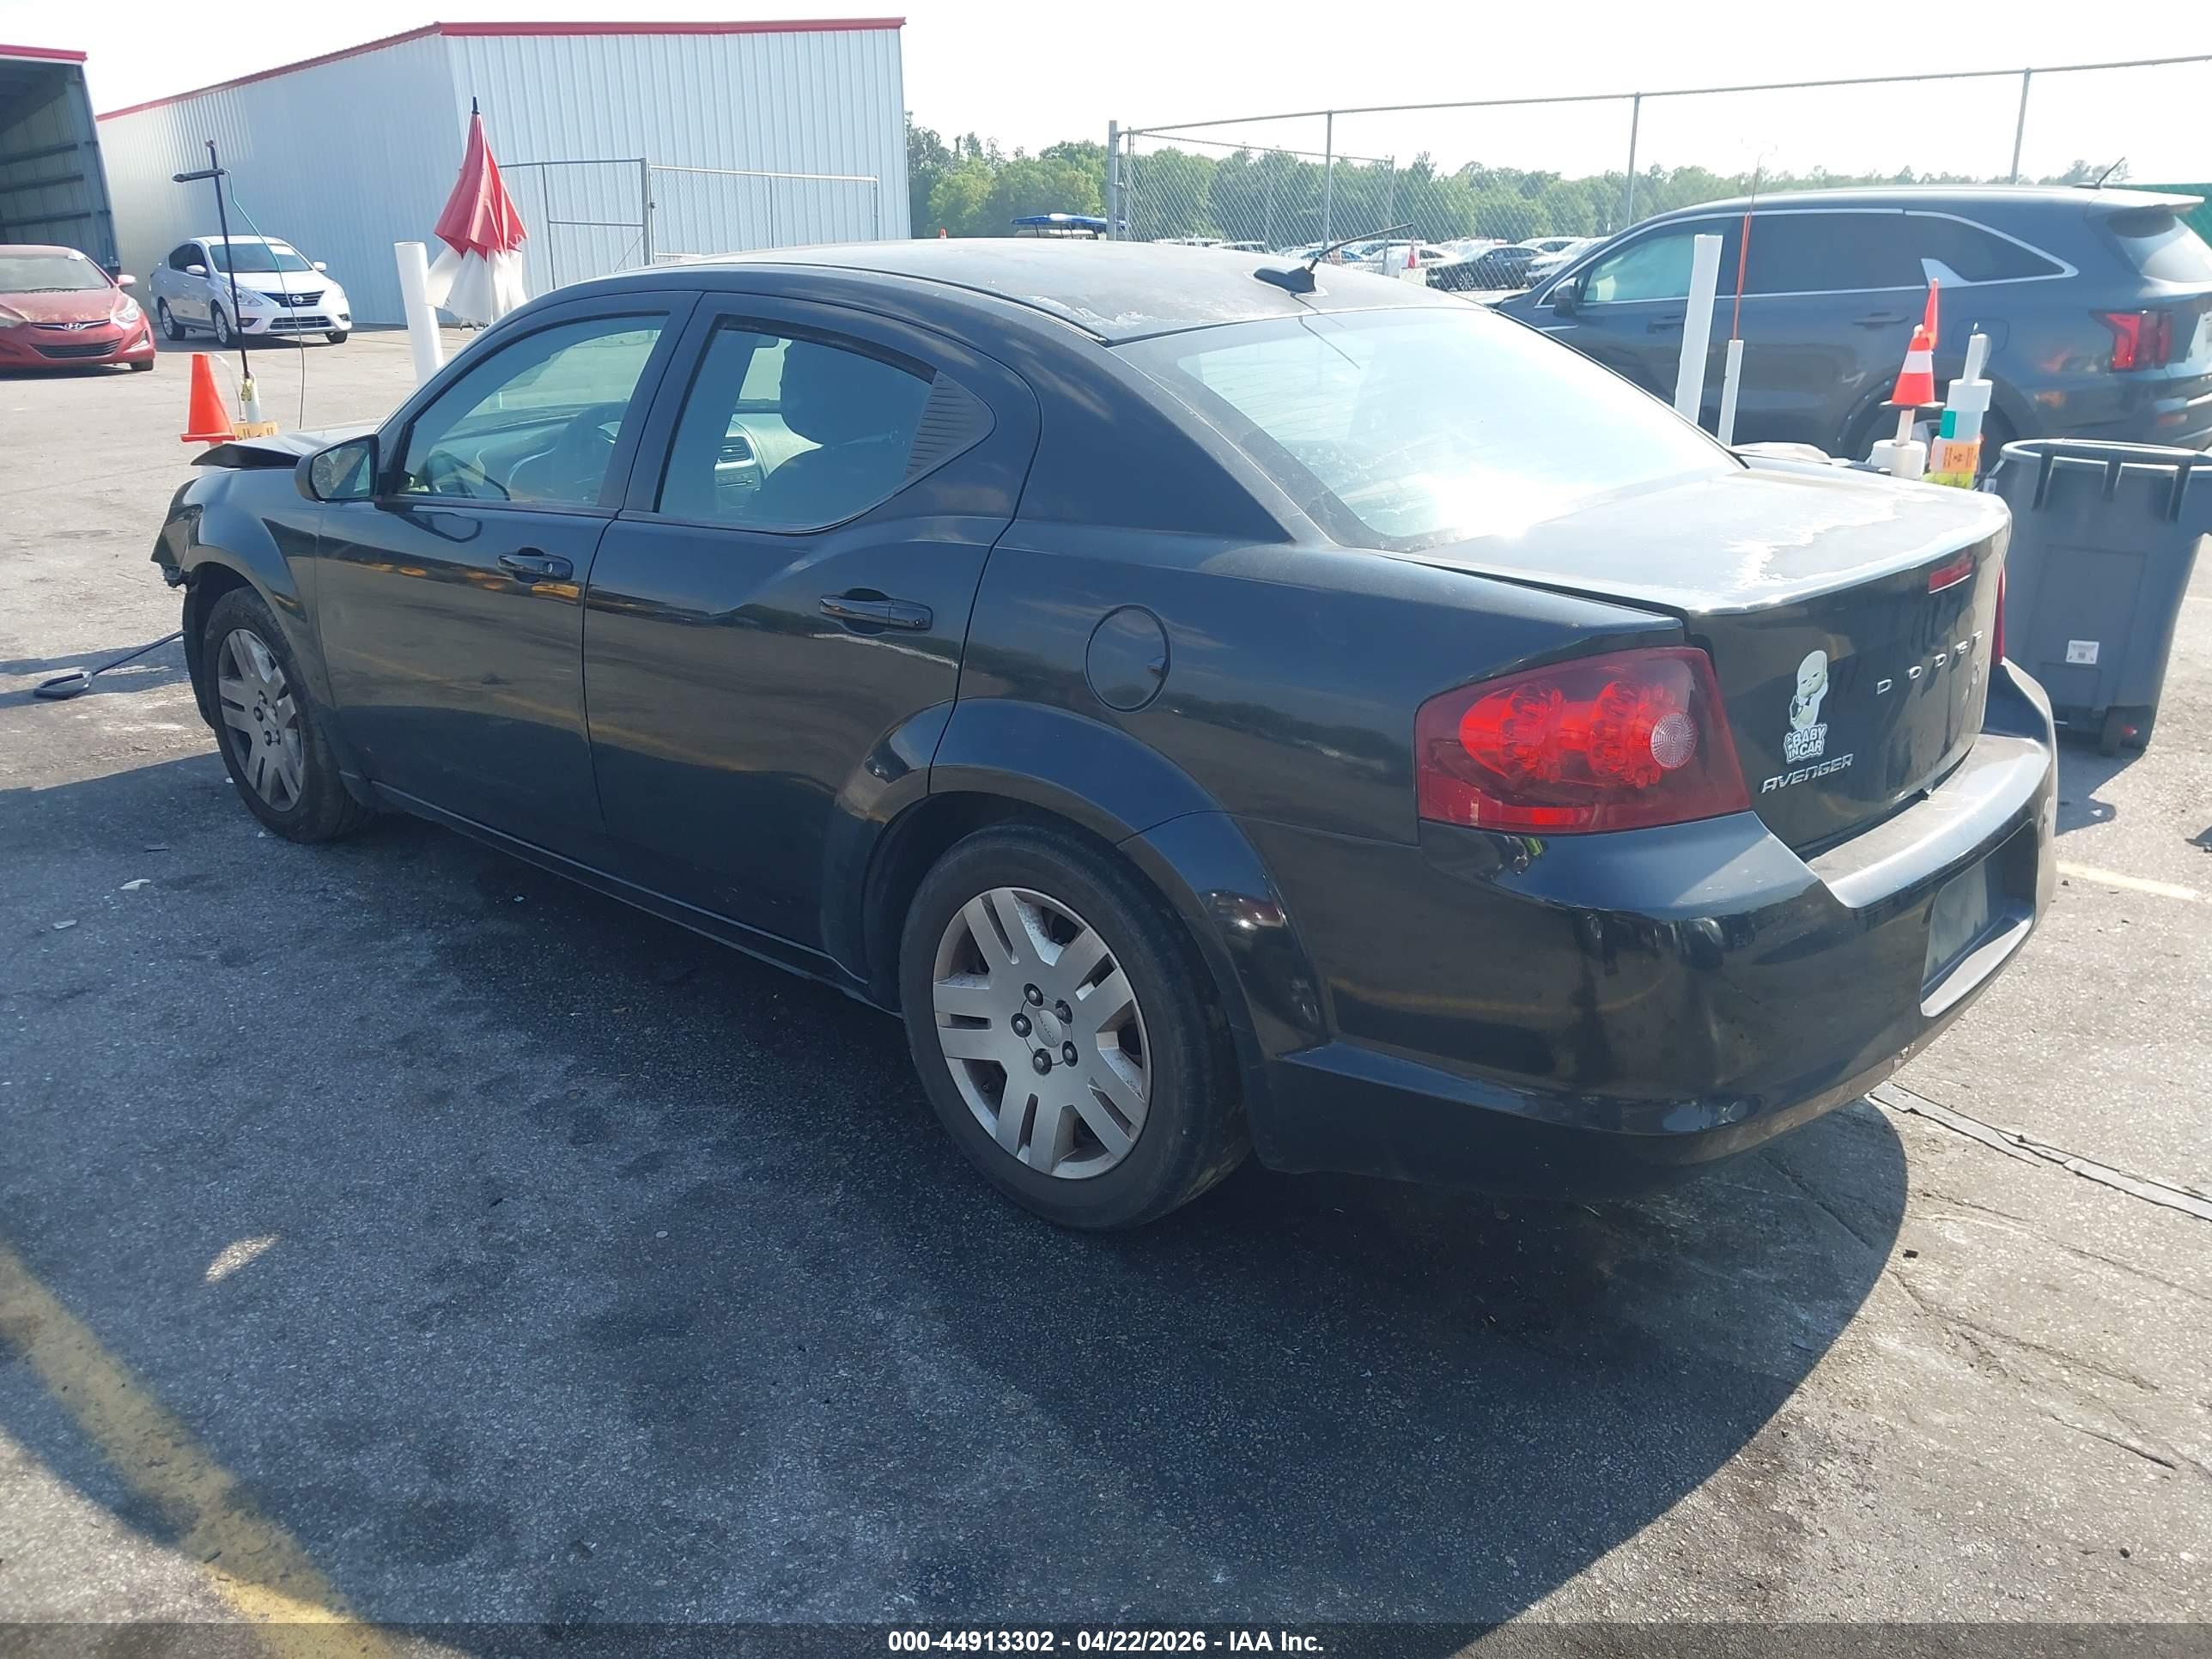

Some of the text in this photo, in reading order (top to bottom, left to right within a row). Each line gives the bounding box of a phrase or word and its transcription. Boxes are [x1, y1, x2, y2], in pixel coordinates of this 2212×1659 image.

[1792, 727, 1826, 748] BABY
[1788, 740, 1823, 759] IN CAR
[1761, 753, 1854, 793] AVENGER
